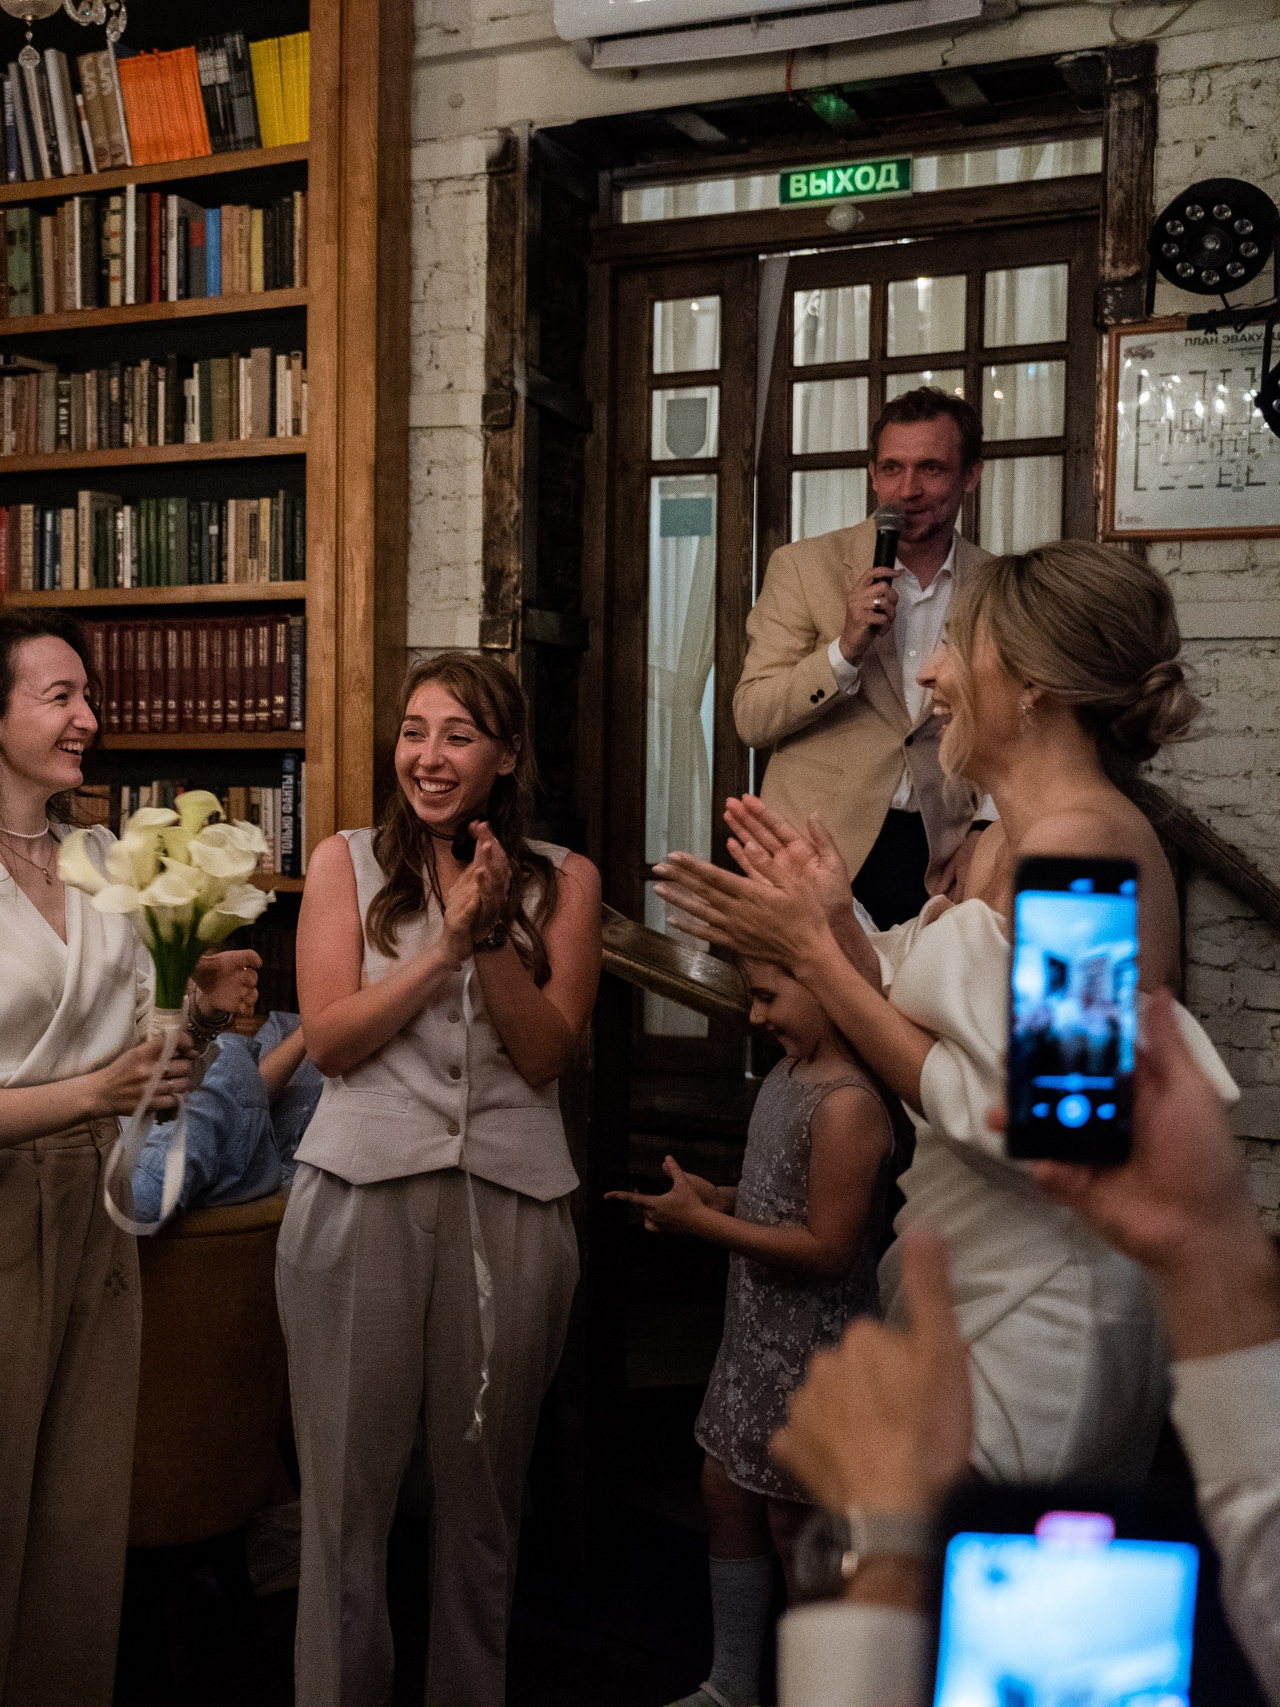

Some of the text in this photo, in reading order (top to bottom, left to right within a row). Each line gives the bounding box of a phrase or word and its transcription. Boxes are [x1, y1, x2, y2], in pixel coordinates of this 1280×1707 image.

[789, 162, 900, 199] ВЫХОД
[1184, 336, 1218, 347] ПЛАН
[282, 774, 294, 855] ТОЛЬКО ФАКТЫ
